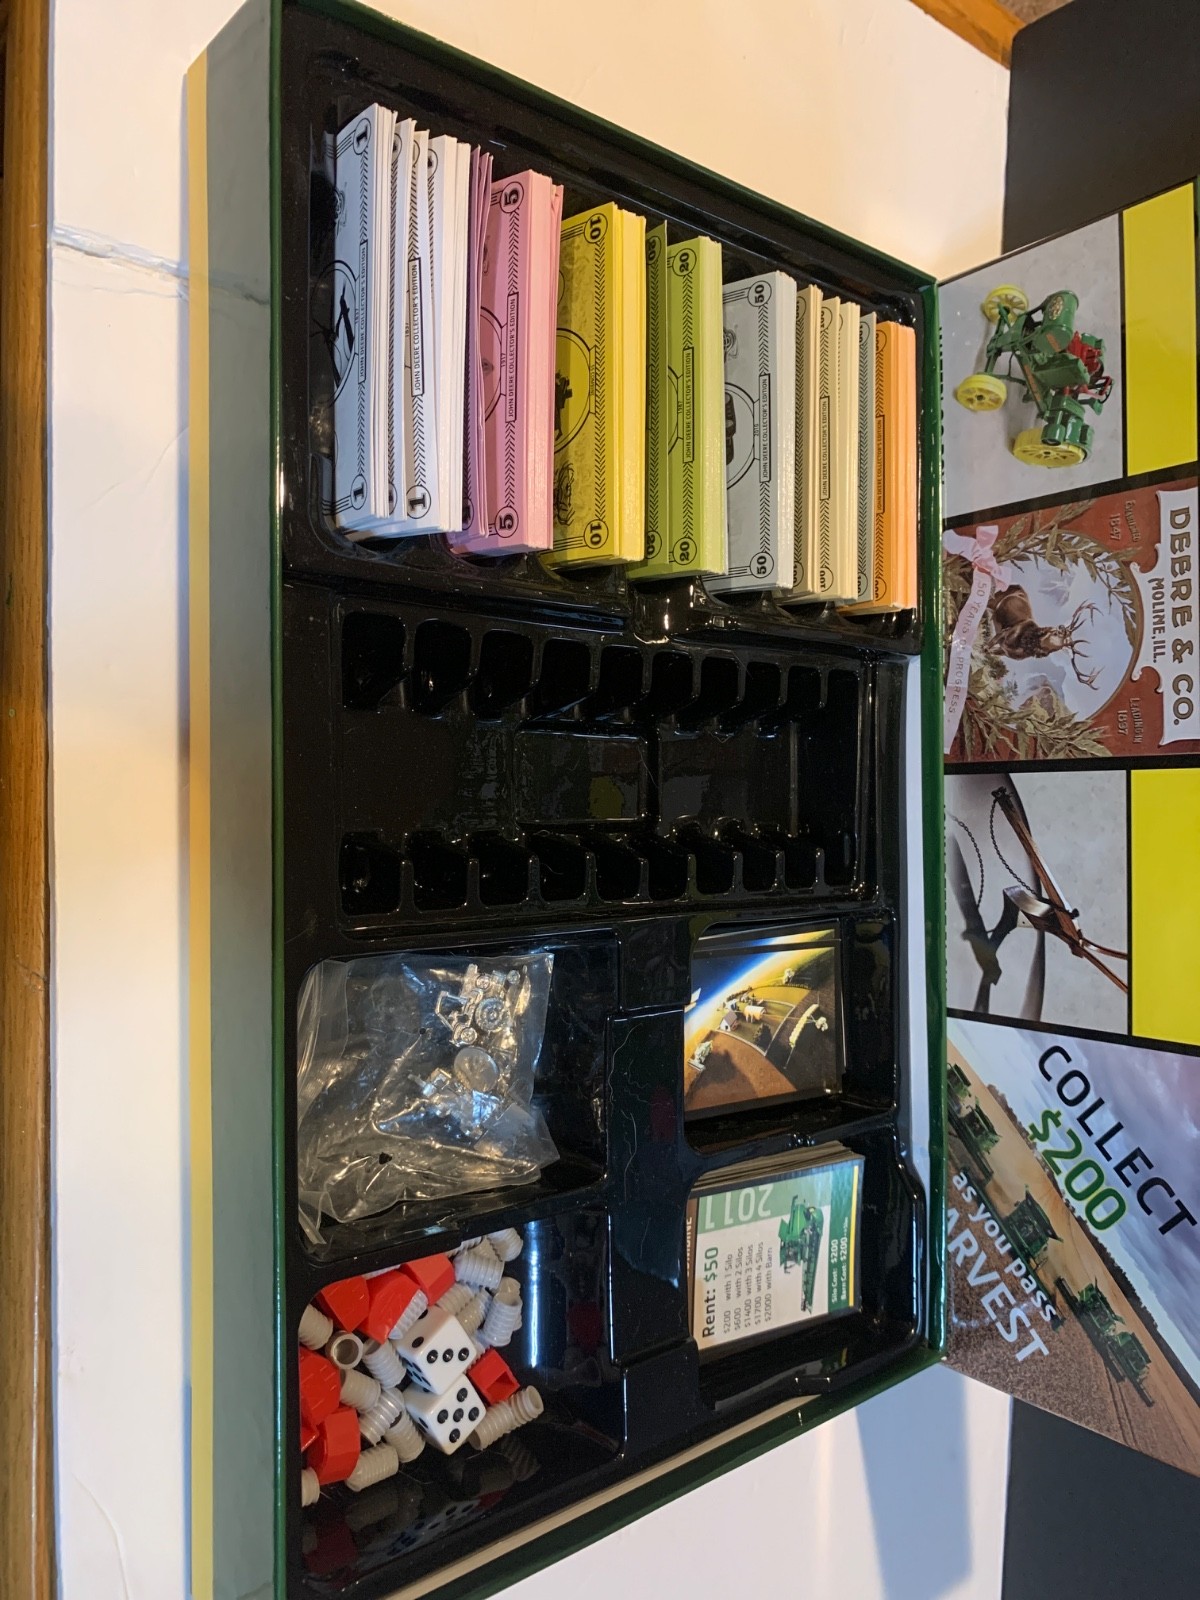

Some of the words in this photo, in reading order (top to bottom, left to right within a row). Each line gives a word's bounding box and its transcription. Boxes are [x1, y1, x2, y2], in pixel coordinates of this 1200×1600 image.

[503, 189, 519, 206] 5
[590, 218, 602, 240] 10
[679, 252, 690, 273] 20
[755, 284, 765, 303] 50
[412, 296, 420, 344] COLLECTOR'S
[500, 513, 514, 530] 5
[1110, 513, 1121, 541] 1847
[590, 523, 602, 546] 10
[679, 540, 690, 561] 20
[756, 555, 767, 575] 50
[1169, 506, 1192, 628] DEERE
[977, 583, 987, 597] 50
[962, 601, 981, 634] YEARS
[1171, 638, 1194, 664] &
[948, 656, 964, 714] PROGRESS
[1172, 674, 1194, 726] CO.
[1117, 710, 1128, 736] 1897
[1038, 1045, 1198, 1236] COLLECT
[1028, 1108, 1128, 1232] $200
[705, 1184, 774, 1230] 2011
[735, 1246, 743, 1269] Silos
[830, 1239, 838, 1263] $200
[840, 1237, 848, 1261] $200
[952, 1170, 974, 1205] as
[968, 1205, 1012, 1254] you
[1005, 1257, 1058, 1323] pass
[704, 1247, 719, 1282] $50
[724, 1254, 732, 1271] Silo
[724, 1280, 732, 1301] with
[734, 1278, 742, 1298] with
[702, 1289, 715, 1338] Rent:
[733, 1307, 741, 1331] $600
[744, 1299, 752, 1328] $1400
[754, 1296, 762, 1325] $1700
[764, 1293, 772, 1322] $2000
[723, 1310, 731, 1334] $200
